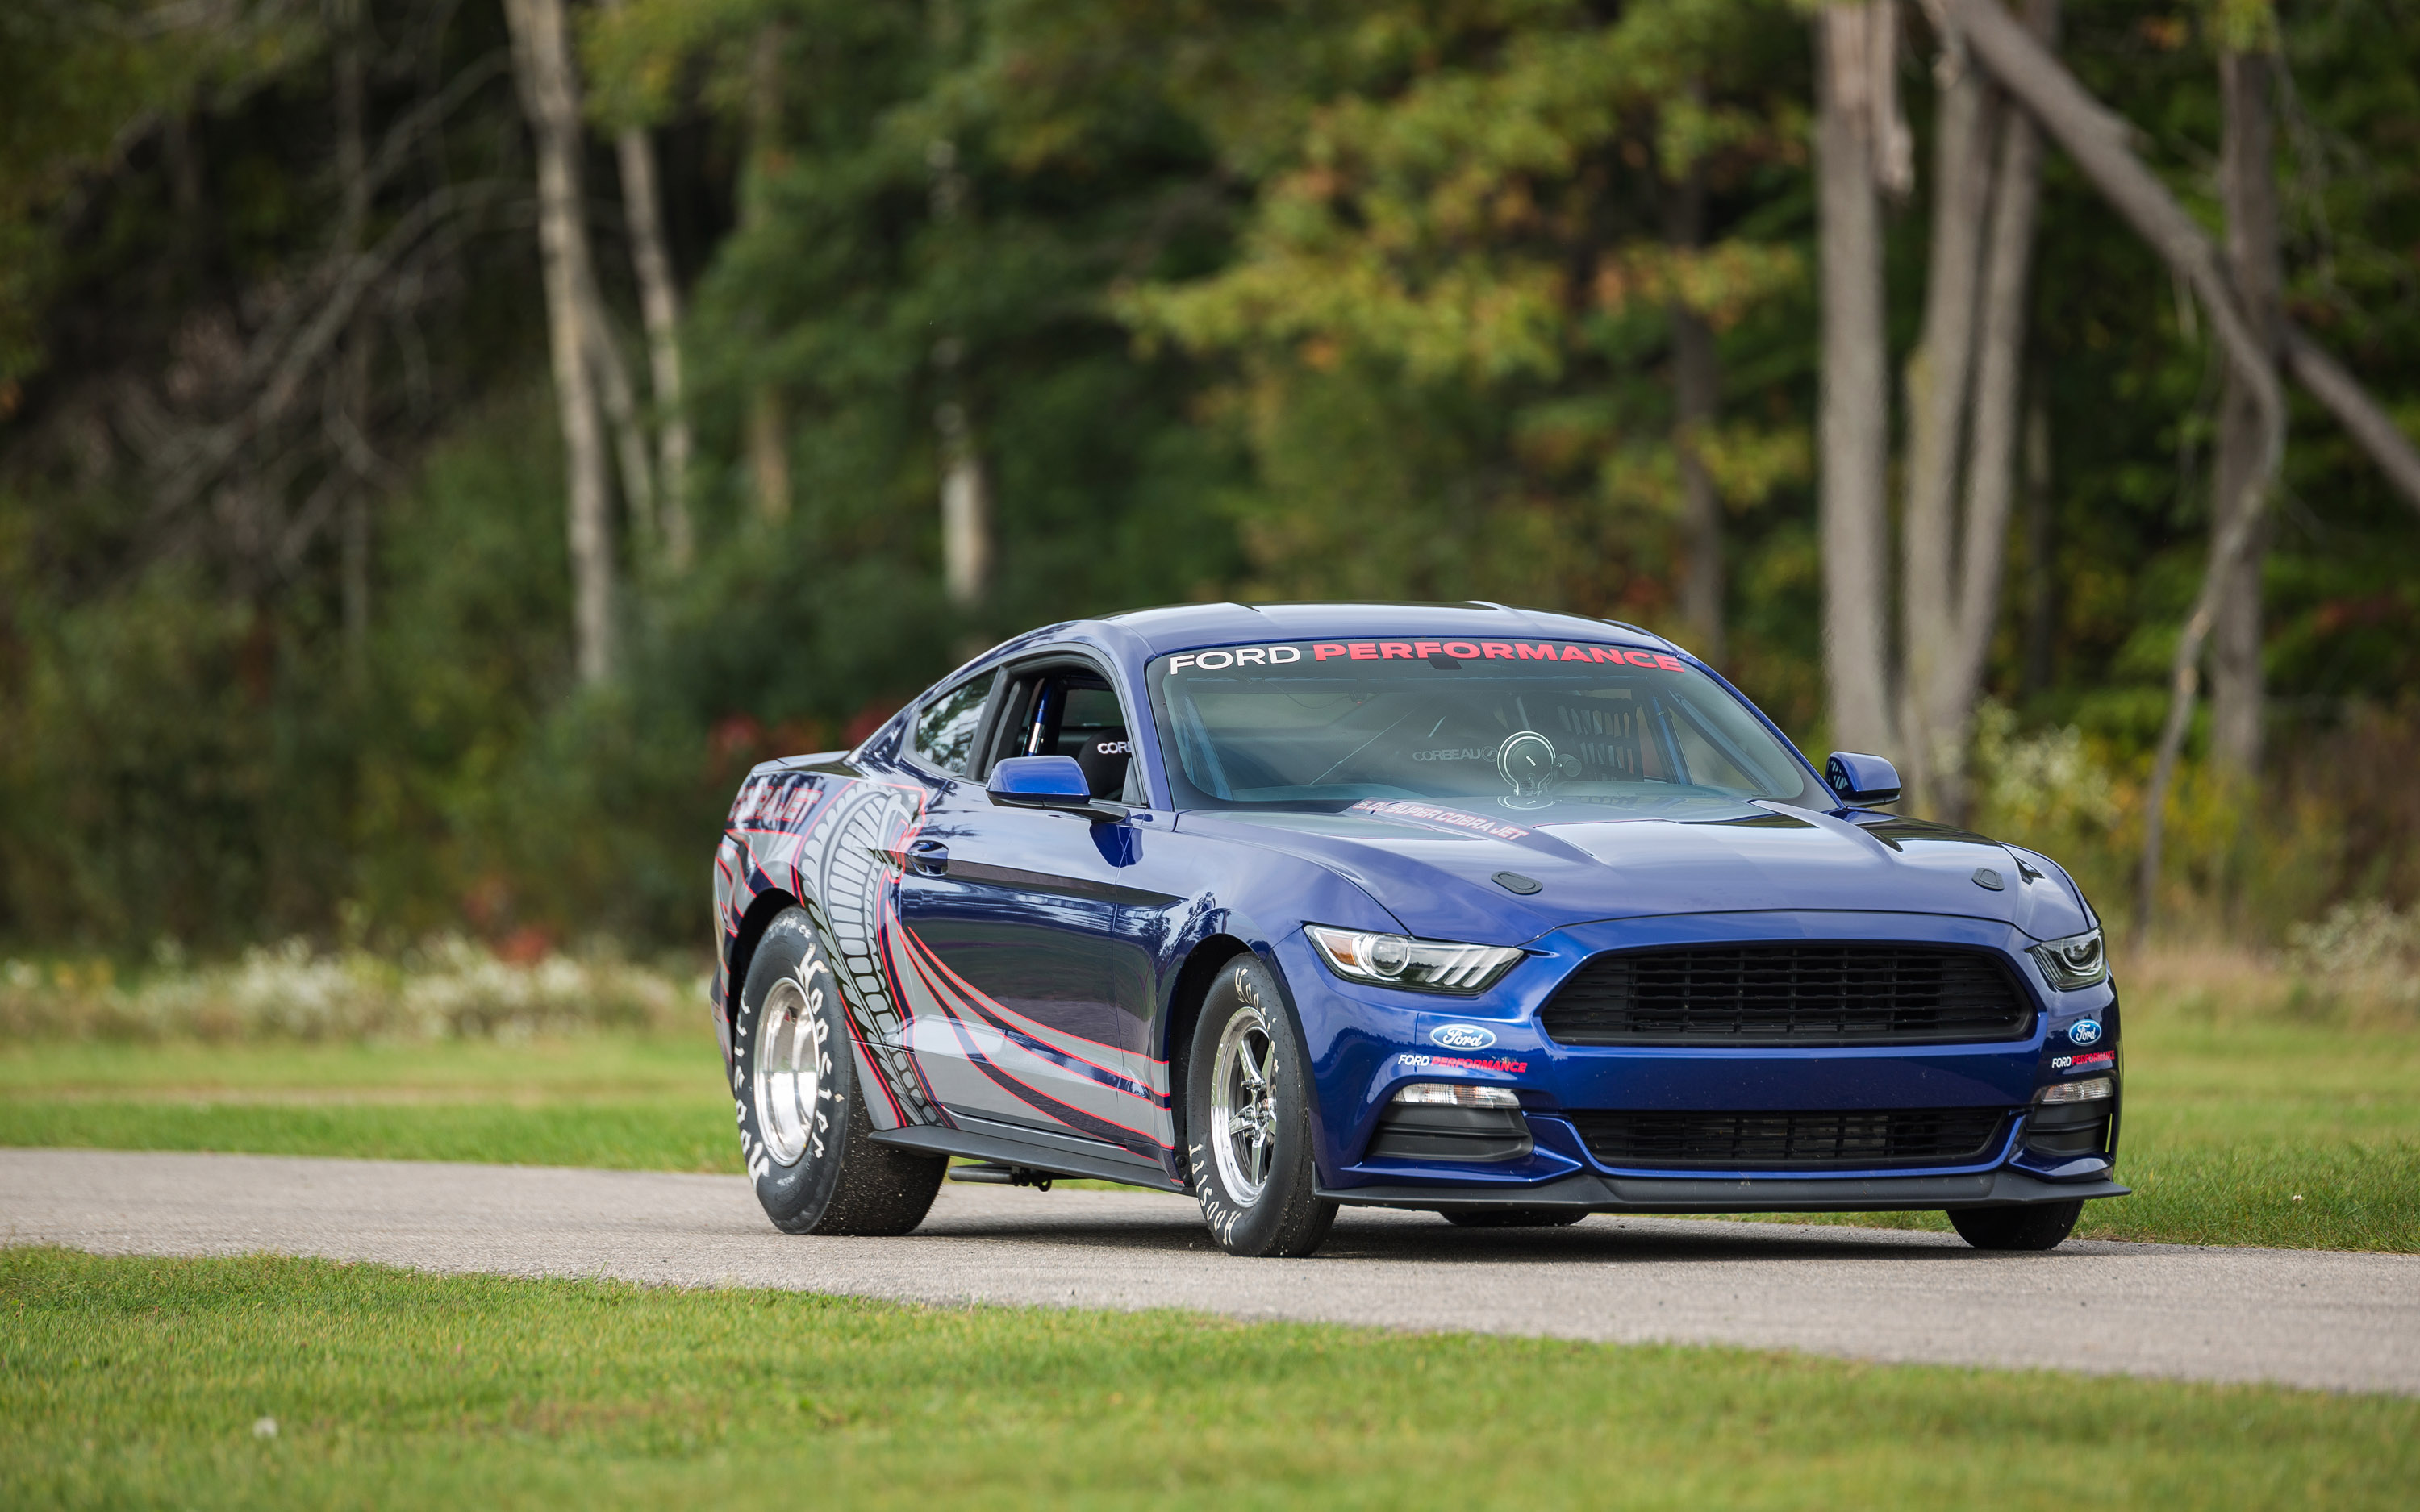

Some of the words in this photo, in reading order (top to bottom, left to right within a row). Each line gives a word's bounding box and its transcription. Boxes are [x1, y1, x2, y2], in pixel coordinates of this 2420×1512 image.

[1170, 646, 1300, 674] FORD
[1313, 641, 1685, 673] PERFORMANCE
[1412, 748, 1481, 761] CORBEAU
[1385, 803, 1442, 820] SUPER
[1435, 811, 1496, 833] COBRA
[1489, 825, 1530, 841] JET
[1442, 1028, 1483, 1048] Ford
[2076, 1023, 2097, 1043] Ford
[1397, 1054, 1430, 1068] FORD
[1431, 1056, 1527, 1073] PERFORMANCE
[2052, 1056, 2072, 1068] FORD
[2072, 1050, 2115, 1065] PERFORMANCE
